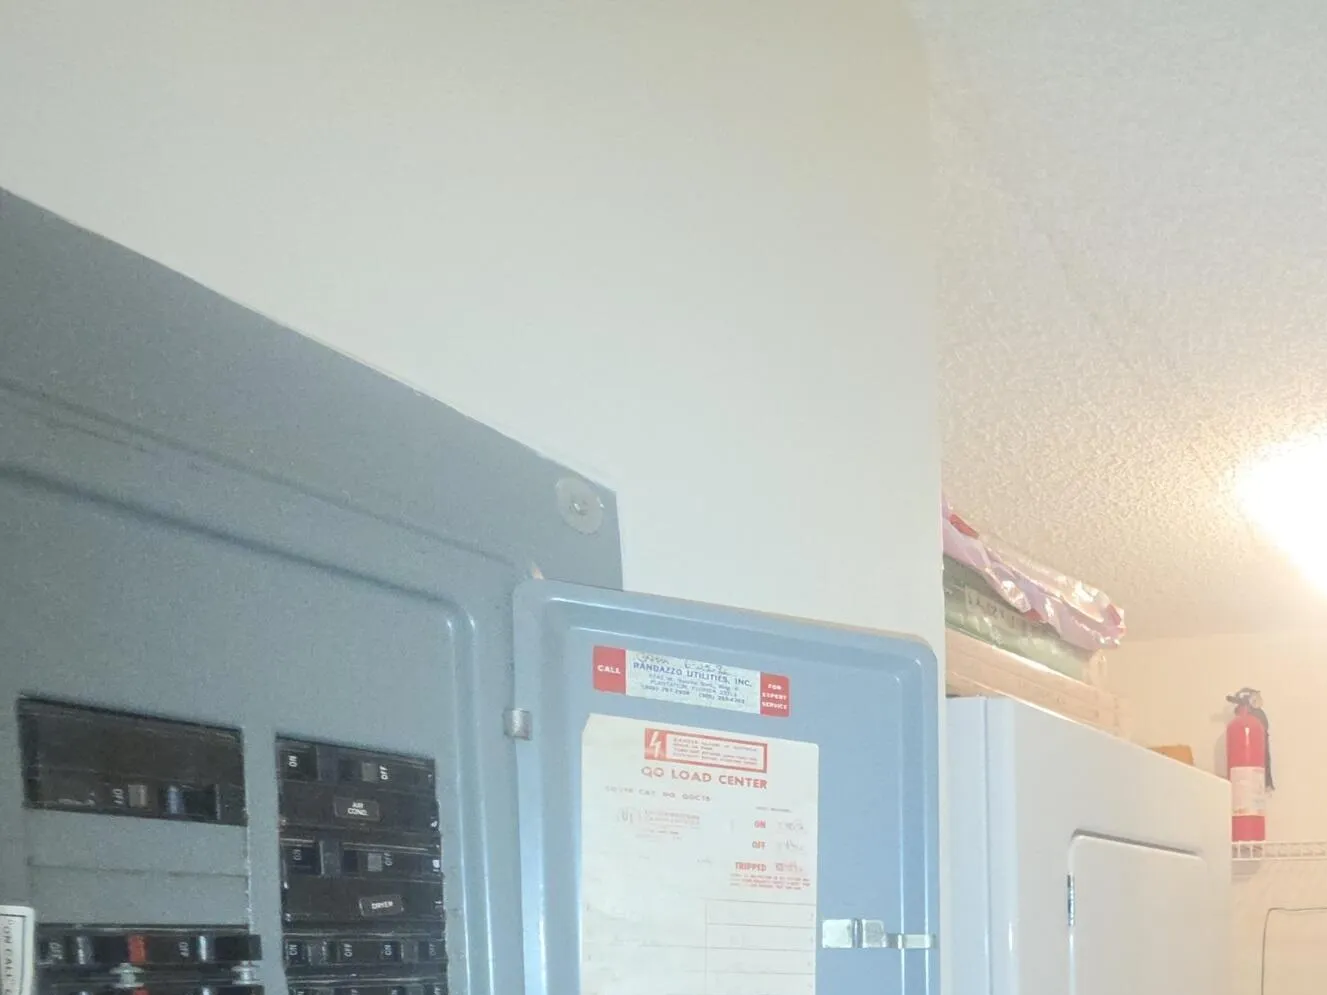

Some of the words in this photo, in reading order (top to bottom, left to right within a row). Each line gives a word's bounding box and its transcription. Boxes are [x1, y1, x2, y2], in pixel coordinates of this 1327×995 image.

[597, 664, 621, 674] CALL
[633, 661, 683, 675] RANDAZZO
[735, 678, 752, 687] INC.
[762, 701, 787, 710] SERVICE
[288, 755, 298, 768] ON
[379, 765, 388, 780] OFF
[671, 768, 712, 783] LOAD
[718, 774, 768, 789] CENTER
[179, 942, 190, 957] OFF
[289, 944, 298, 956] ON
[343, 943, 353, 957] OFF
[384, 944, 392, 956] ON
